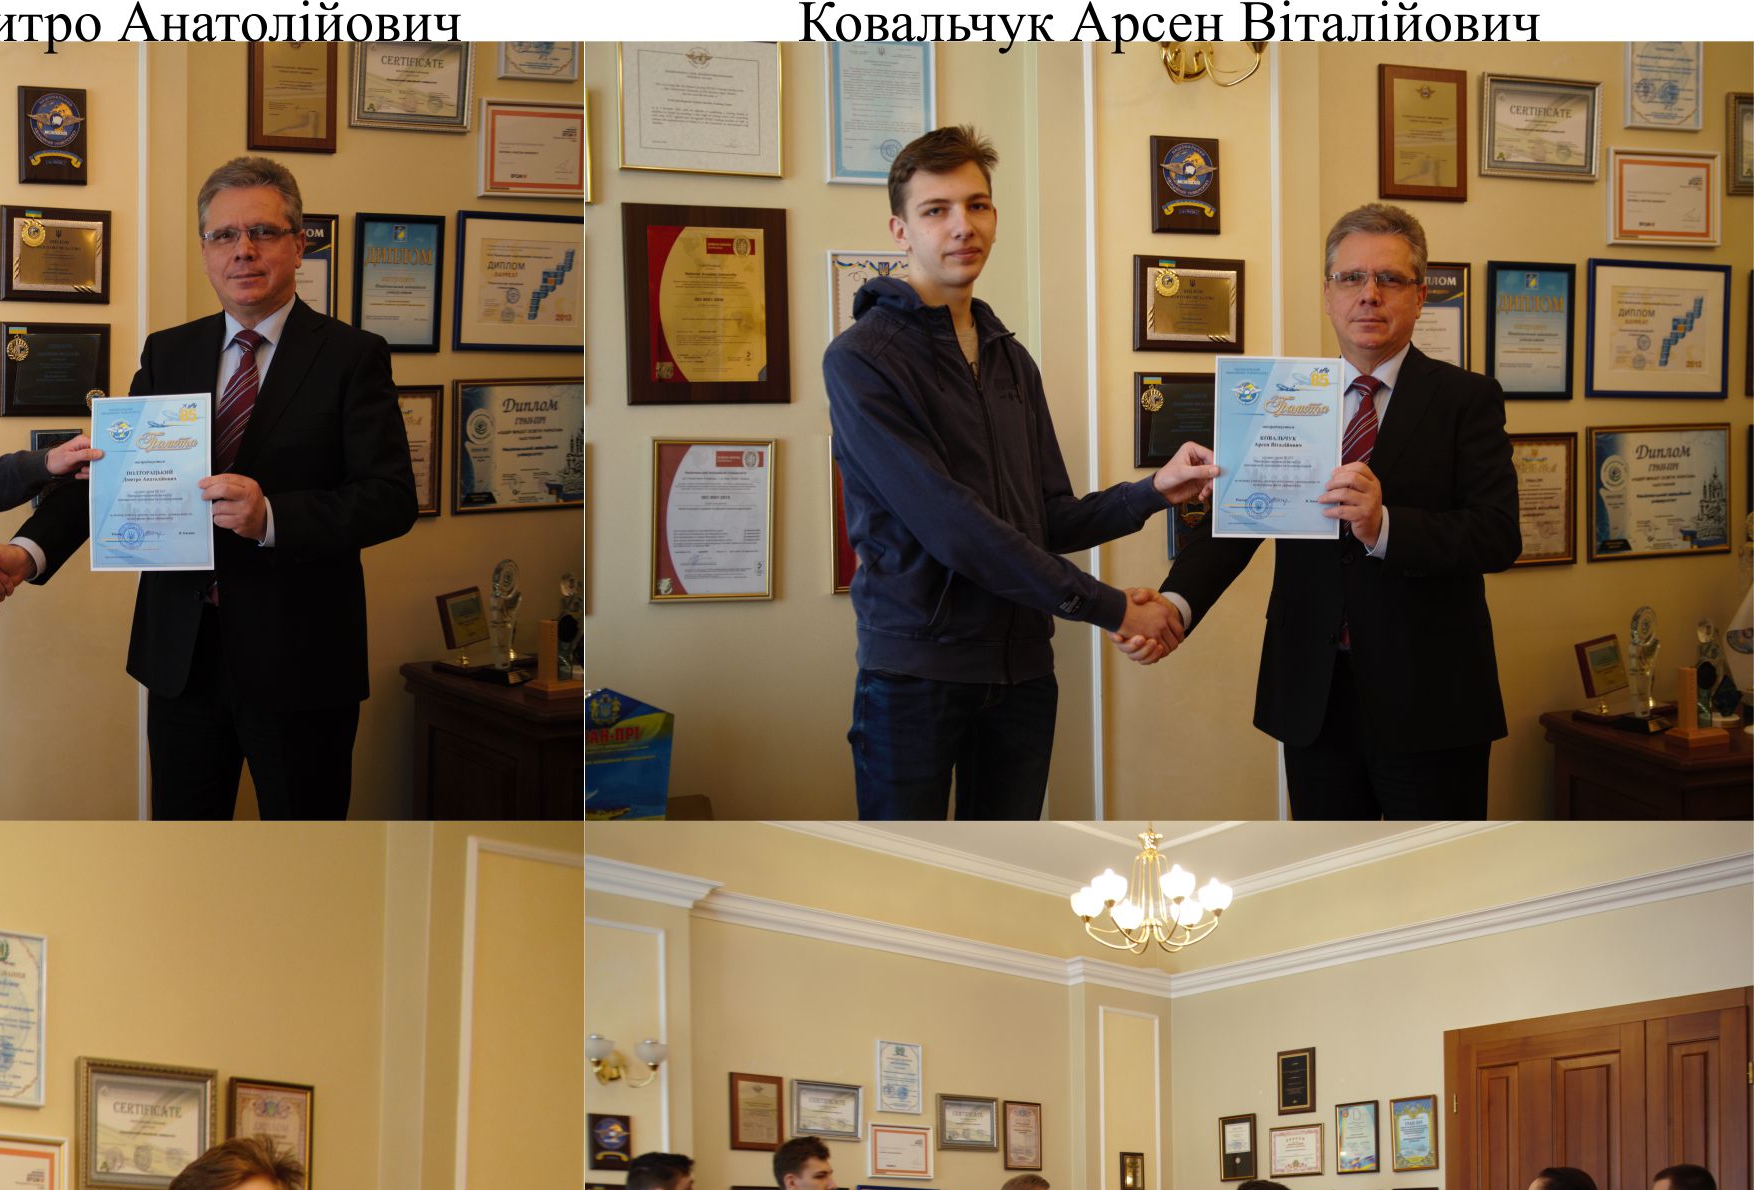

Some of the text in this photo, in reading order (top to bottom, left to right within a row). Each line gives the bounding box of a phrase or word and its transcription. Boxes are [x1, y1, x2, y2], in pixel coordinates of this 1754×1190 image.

[380, 55, 444, 69] CERTIFICATE
[1509, 104, 1572, 119] CERTIFICATE
[365, 246, 433, 267] ДИПЛОМ
[487, 261, 525, 271] ДИПЛОМ
[1618, 308, 1655, 318] ДИПЛОМ
[503, 398, 558, 413] Диплом
[1635, 444, 1691, 460] Диплом
[585, 726, 640, 745] РАН-ПРІ
[112, 1101, 182, 1119] CERTIFICATE
